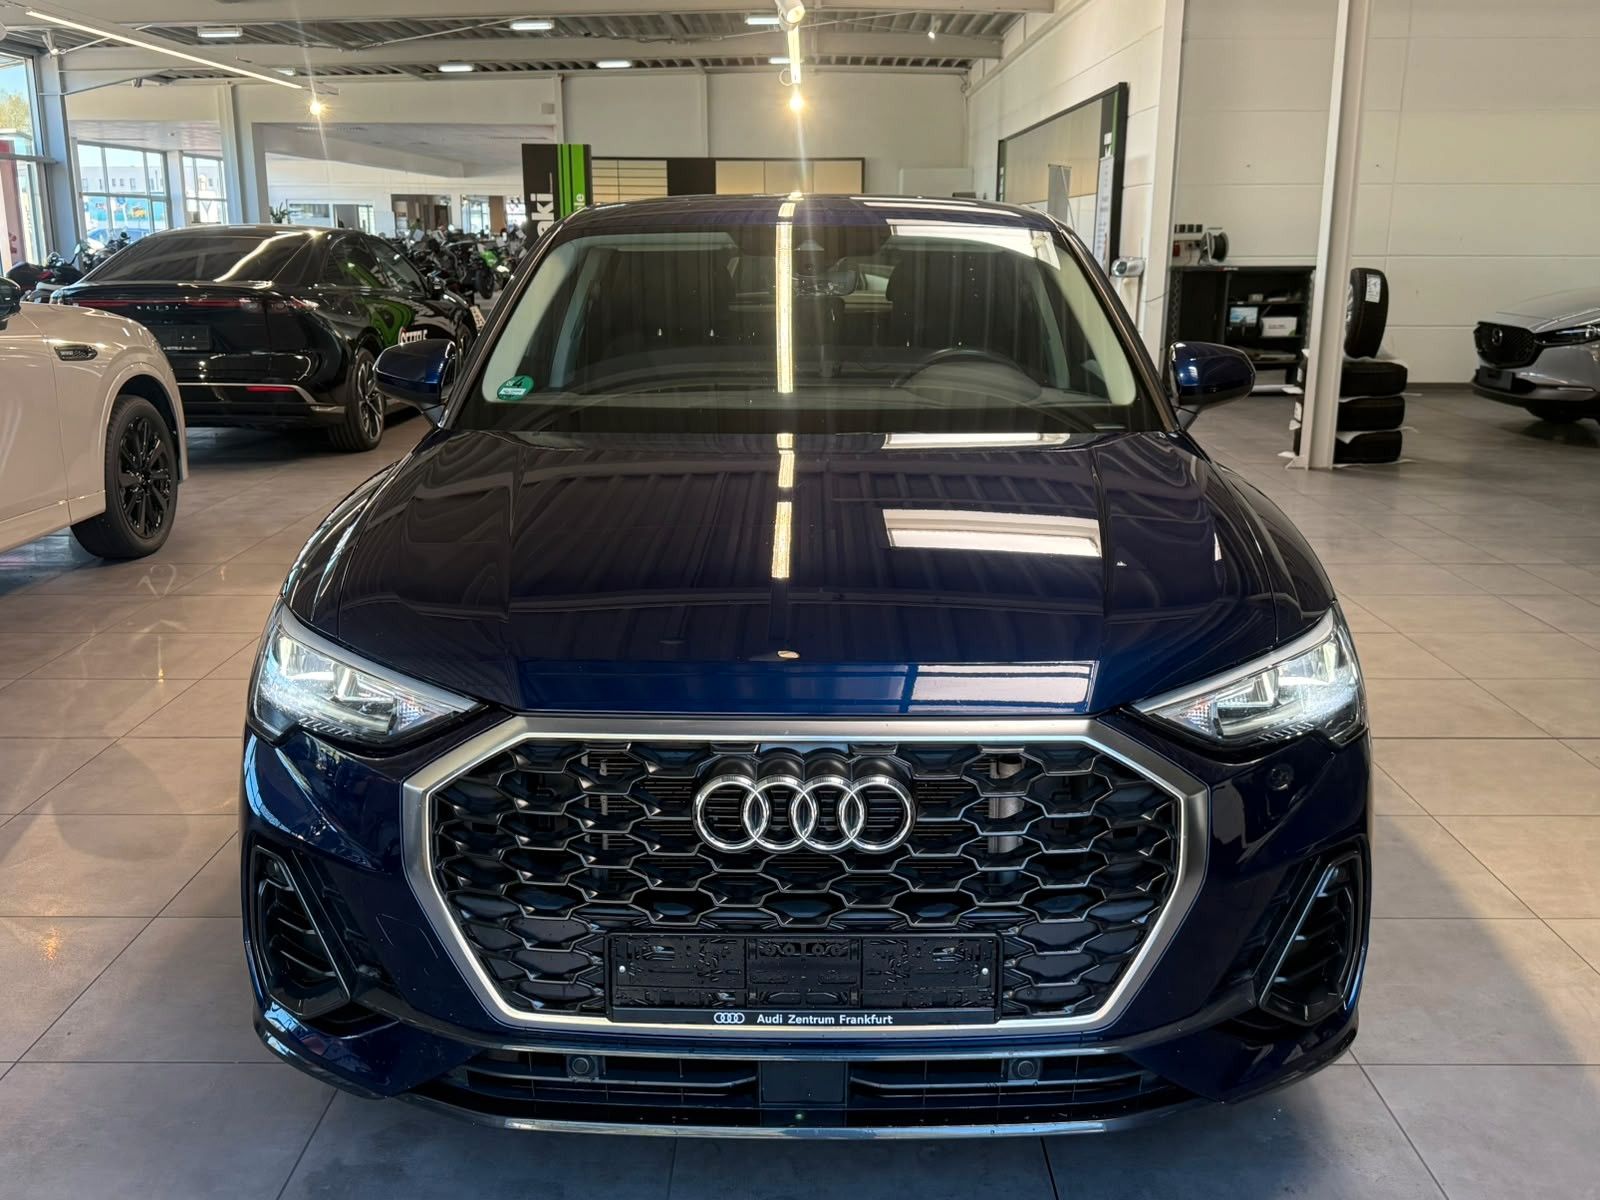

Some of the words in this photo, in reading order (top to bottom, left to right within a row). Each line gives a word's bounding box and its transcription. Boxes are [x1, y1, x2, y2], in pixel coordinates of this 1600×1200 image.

[757, 1014, 783, 1024] Audi
[788, 1014, 835, 1024] Zentrum
[839, 1014, 893, 1025] Frankfurt
